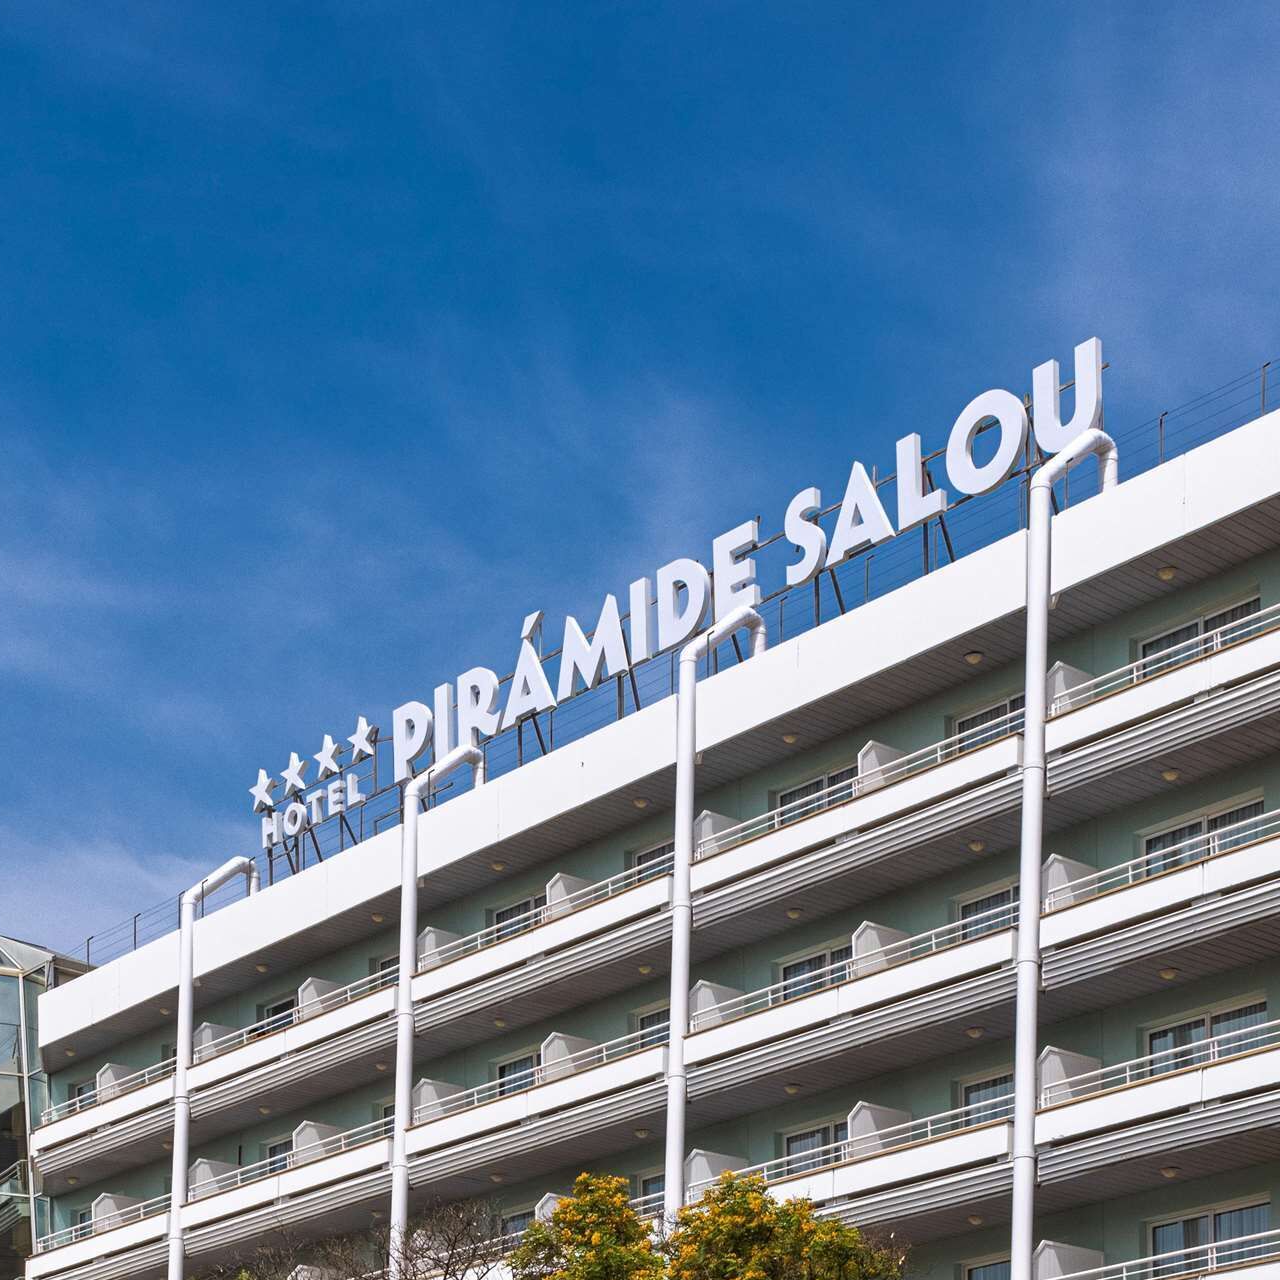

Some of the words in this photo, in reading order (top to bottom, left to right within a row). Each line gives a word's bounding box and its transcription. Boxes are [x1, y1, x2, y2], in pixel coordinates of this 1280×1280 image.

[262, 773, 366, 849] HOTEL
[393, 520, 761, 783] PIRÁMIDE
[784, 336, 1102, 587] SALOU
